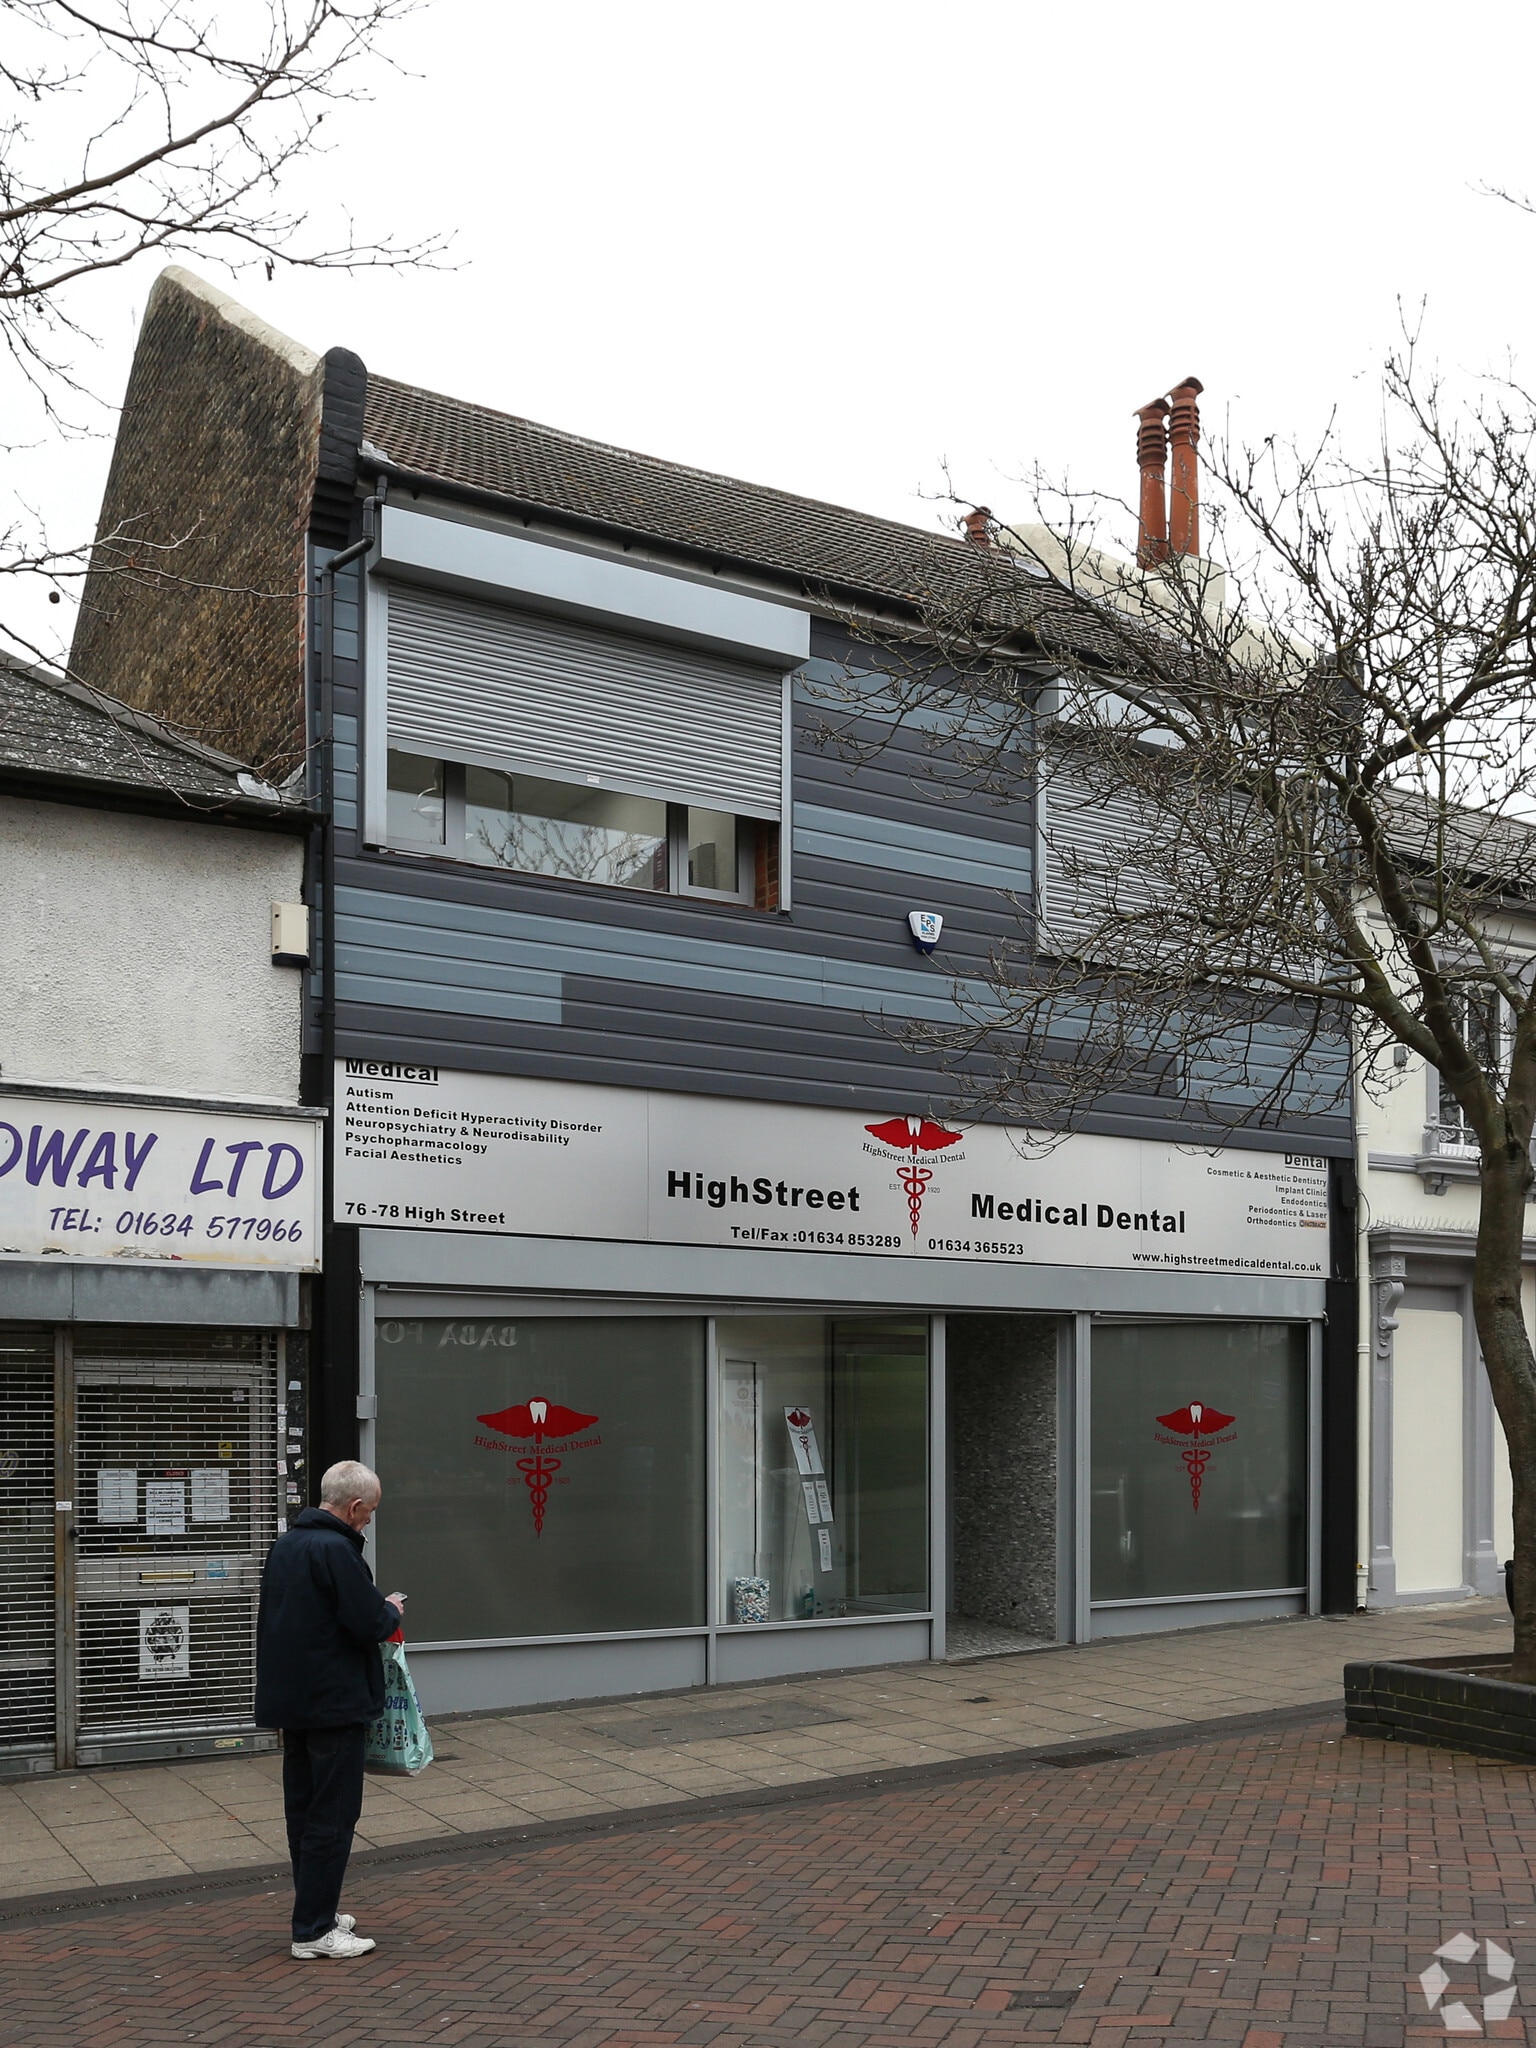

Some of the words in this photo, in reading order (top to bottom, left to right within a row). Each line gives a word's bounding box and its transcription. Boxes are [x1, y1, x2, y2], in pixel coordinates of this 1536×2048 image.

[921, 914, 936, 933] EPS
[346, 1058, 439, 1082] Medical
[346, 1087, 394, 1100] Autism
[346, 1102, 410, 1117] Attention
[414, 1107, 458, 1121] Deficit
[461, 1112, 547, 1130] Hyperactivity
[550, 1120, 603, 1134] Disorder
[345, 1117, 457, 1137] Neuropsychiatry
[460, 1126, 470, 1137] &
[473, 1127, 570, 1146] Neurodisability
[345, 1132, 488, 1155] Psychopharmacology
[345, 1147, 387, 1160] Facial
[390, 1150, 462, 1165] Aesthetics
[862, 1142, 905, 1163] HighStreet
[907, 1155, 938, 1165] Medical
[940, 1152, 966, 1164] Dental
[1284, 1153, 1327, 1169] Dental
[189, 1137, 304, 1200] LTD
[1207, 1167, 1245, 1178] Cosmetic
[1254, 1171, 1291, 1183] Aesthetic
[1293, 1176, 1327, 1188] Dentistry
[889, 1183, 901, 1191] EST
[927, 1186, 940, 1194] 1920
[1275, 1185, 1305, 1195] Implant
[1306, 1188, 1327, 1197] Clinic
[667, 1170, 861, 1212] HighStreet
[971, 1192, 1087, 1228] Medical
[1097, 1203, 1186, 1234] Dental
[1281, 1197, 1327, 1208] Endodontics
[345, 1202, 368, 1217] 76
[405, 1206, 446, 1224] High
[450, 1208, 506, 1225] Street
[1248, 1205, 1297, 1217] Periodontics
[1299, 1209, 1305, 1217] &
[1306, 1210, 1327, 1219] Laser
[50, 1207, 102, 1234] TEL:
[115, 1210, 194, 1237] 01634
[206, 1216, 303, 1243] 577966
[1246, 1216, 1297, 1228] Orthodontics
[847, 1233, 902, 1249] 853289
[928, 1238, 971, 1253] 01634
[974, 1241, 1024, 1256] 365523
[1132, 1253, 1322, 1272] www.highstreetmedicaldental.co.uk
[474, 1435, 526, 1455] HighStreet
[529, 1443, 568, 1455] Medical
[570, 1435, 602, 1451] Dental
[1154, 1433, 1188, 1448] HighStreet
[1190, 1438, 1216, 1448] Medical
[1217, 1432, 1238, 1444] Dental
